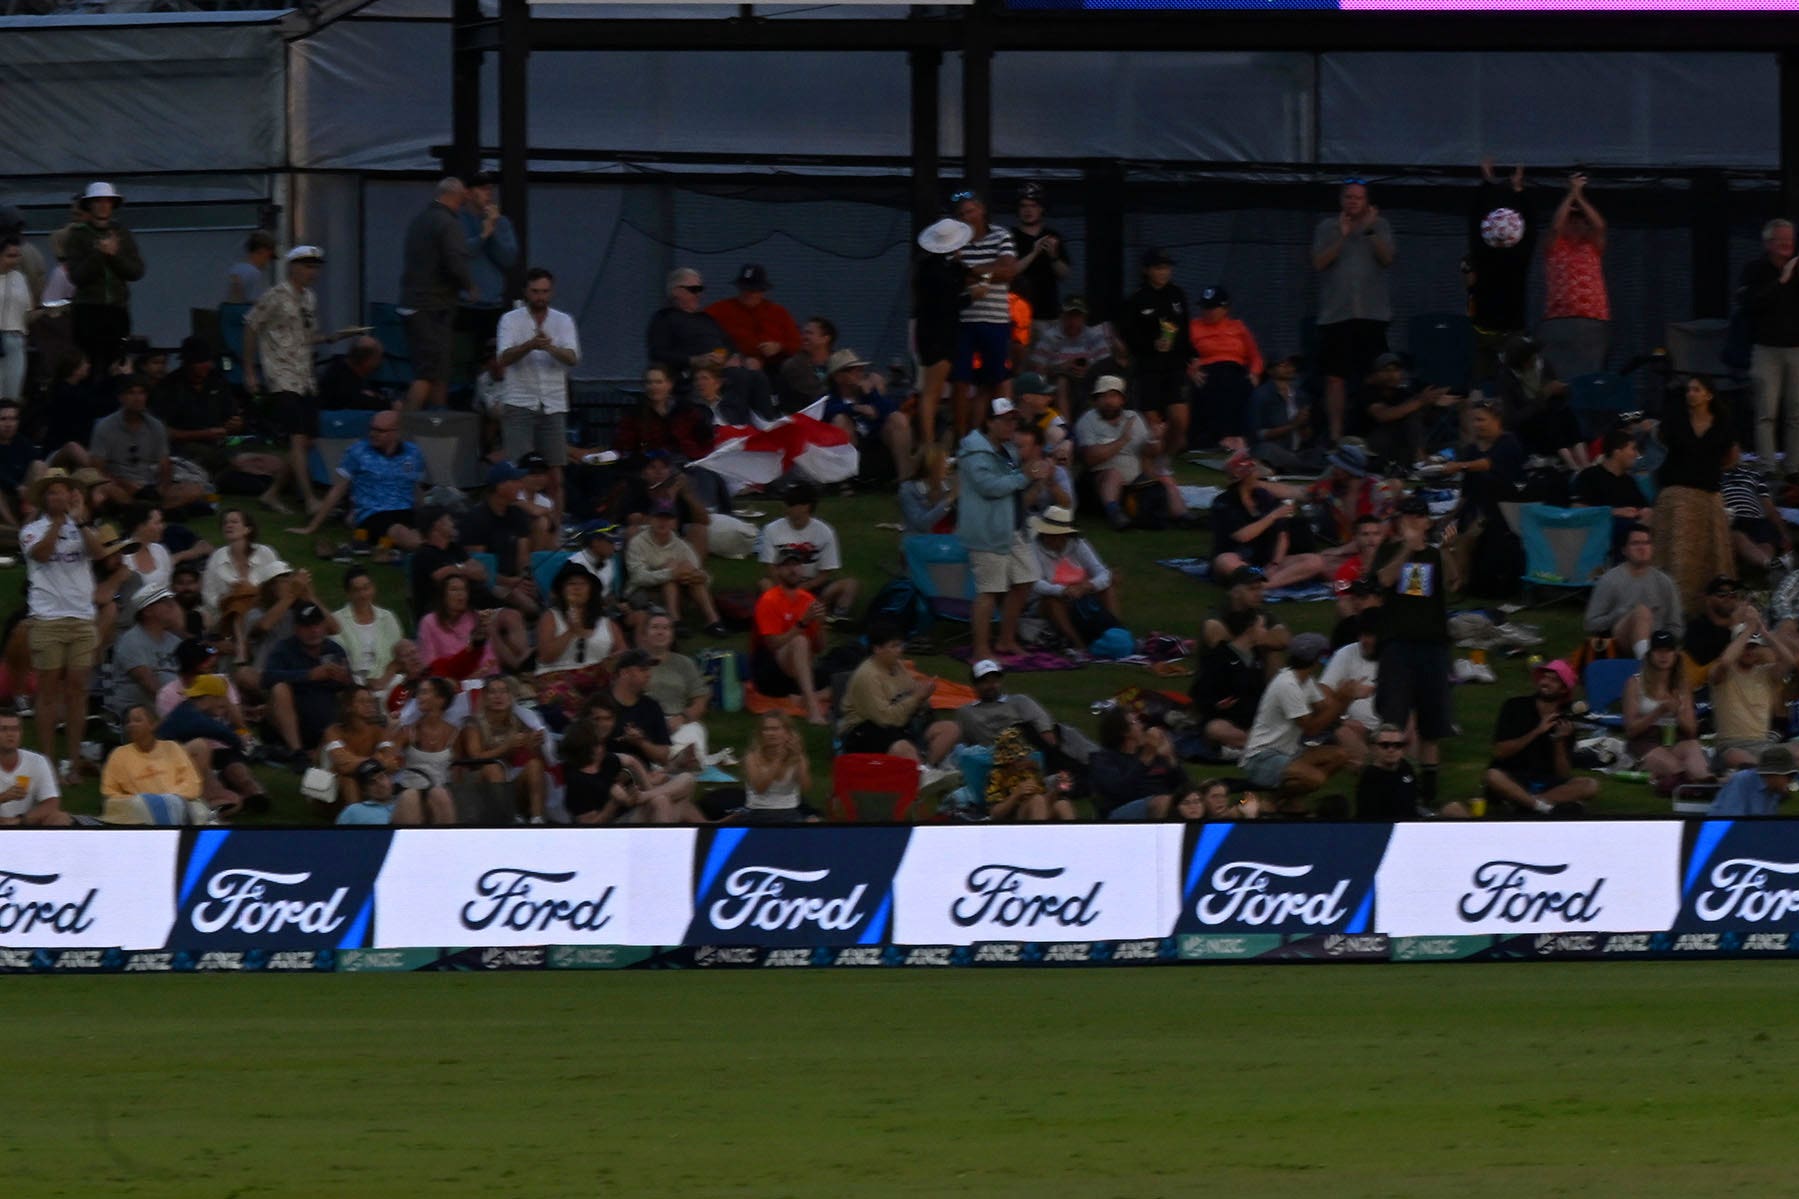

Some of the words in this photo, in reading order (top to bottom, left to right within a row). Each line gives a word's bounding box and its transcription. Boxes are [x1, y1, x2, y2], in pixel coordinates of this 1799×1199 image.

[461, 868, 614, 932] Ford
[709, 865, 869, 932] Ford
[951, 865, 1104, 927] Ford
[1196, 861, 1352, 926] Ford
[1458, 860, 1605, 922] Ford
[192, 868, 351, 935] Ford
[1044, 942, 1092, 960] ANZ
[1113, 941, 1160, 959] ANZ
[1603, 933, 1651, 952] ANZ
[1674, 933, 1720, 951] ANZ
[1743, 933, 1789, 951] ANZ
[0, 950, 33, 968] NZ
[55, 951, 103, 968] ANZ
[196, 953, 243, 969] ANZ
[268, 952, 314, 968] ANZ
[765, 949, 811, 966] ANZ
[835, 947, 881, 965] ANZ
[904, 947, 952, 965] ANZ
[975, 943, 1021, 961] ANZ
[126, 953, 172, 971] ANZ
